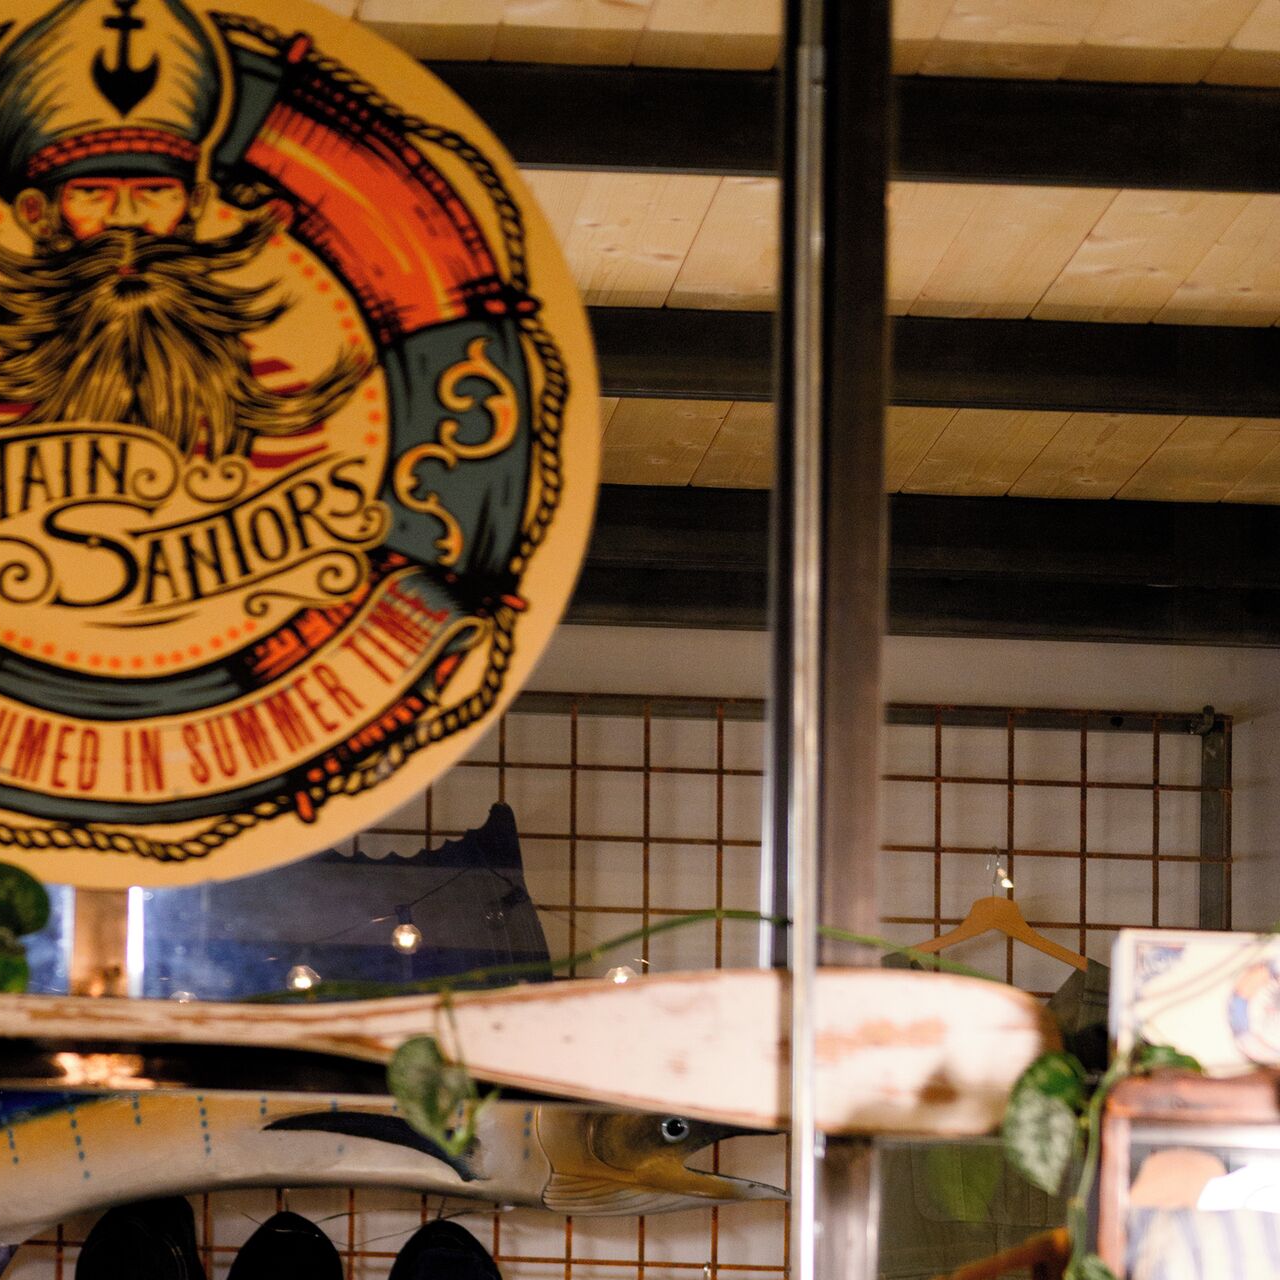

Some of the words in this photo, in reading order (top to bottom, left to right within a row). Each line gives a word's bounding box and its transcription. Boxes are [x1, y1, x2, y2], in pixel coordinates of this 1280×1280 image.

[42, 452, 387, 608] SANTORS
[122, 729, 165, 792] IN
[181, 661, 365, 785] SUMMER
[341, 579, 450, 686] TIME
